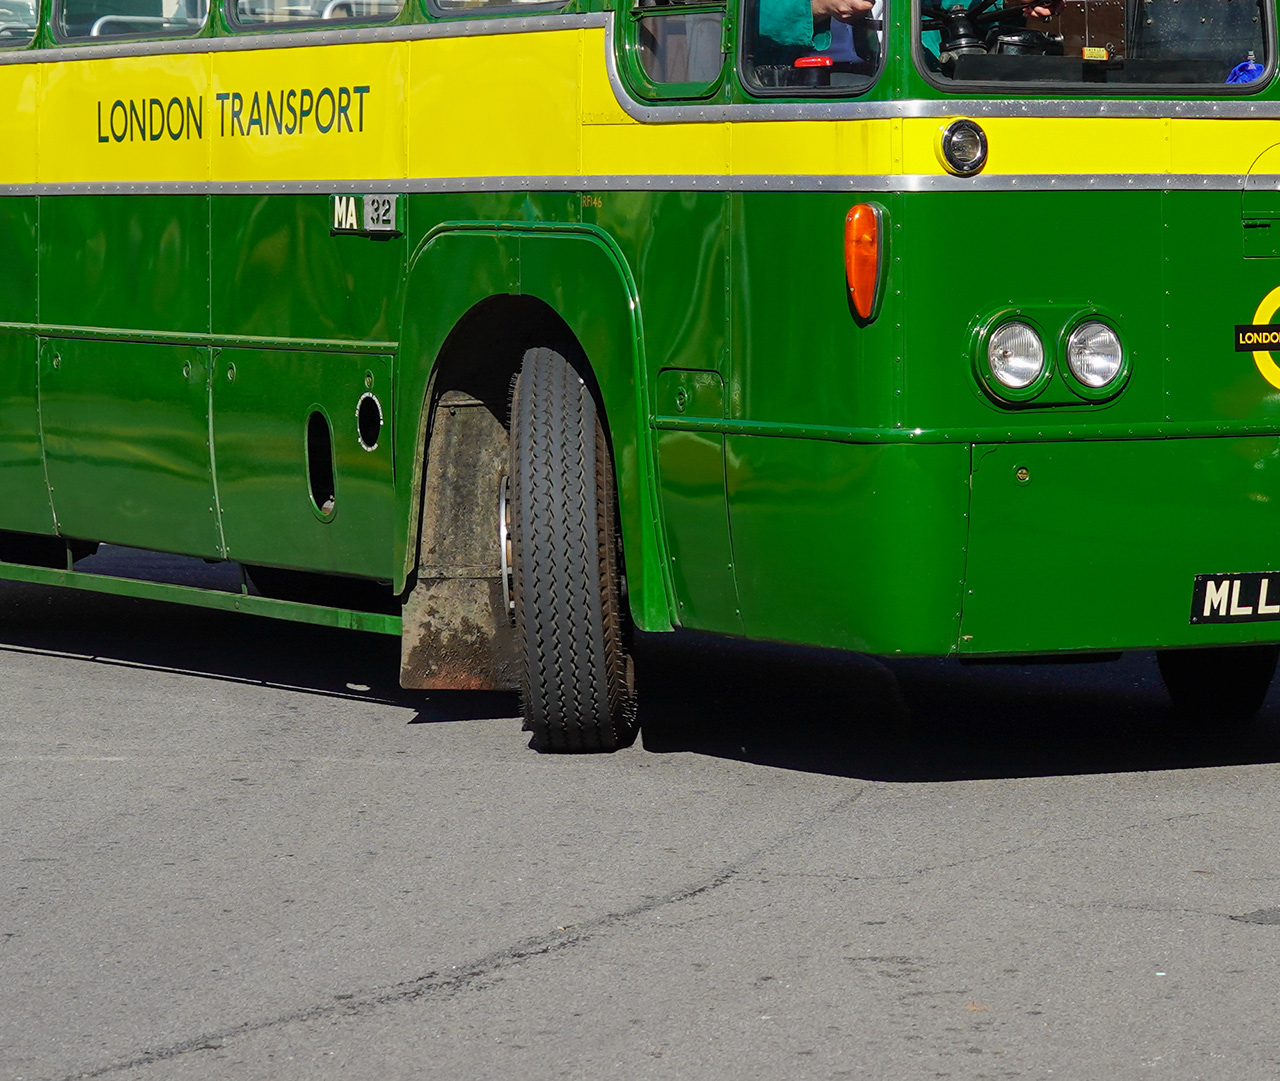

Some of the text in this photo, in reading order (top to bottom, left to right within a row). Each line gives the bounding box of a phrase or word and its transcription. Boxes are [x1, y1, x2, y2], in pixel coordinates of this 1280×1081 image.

[97, 85, 371, 143] LONDON TRANSPORT
[333, 195, 392, 229] MA 32
[582, 195, 603, 208] RF146
[1202, 578, 1280, 617] MLL
